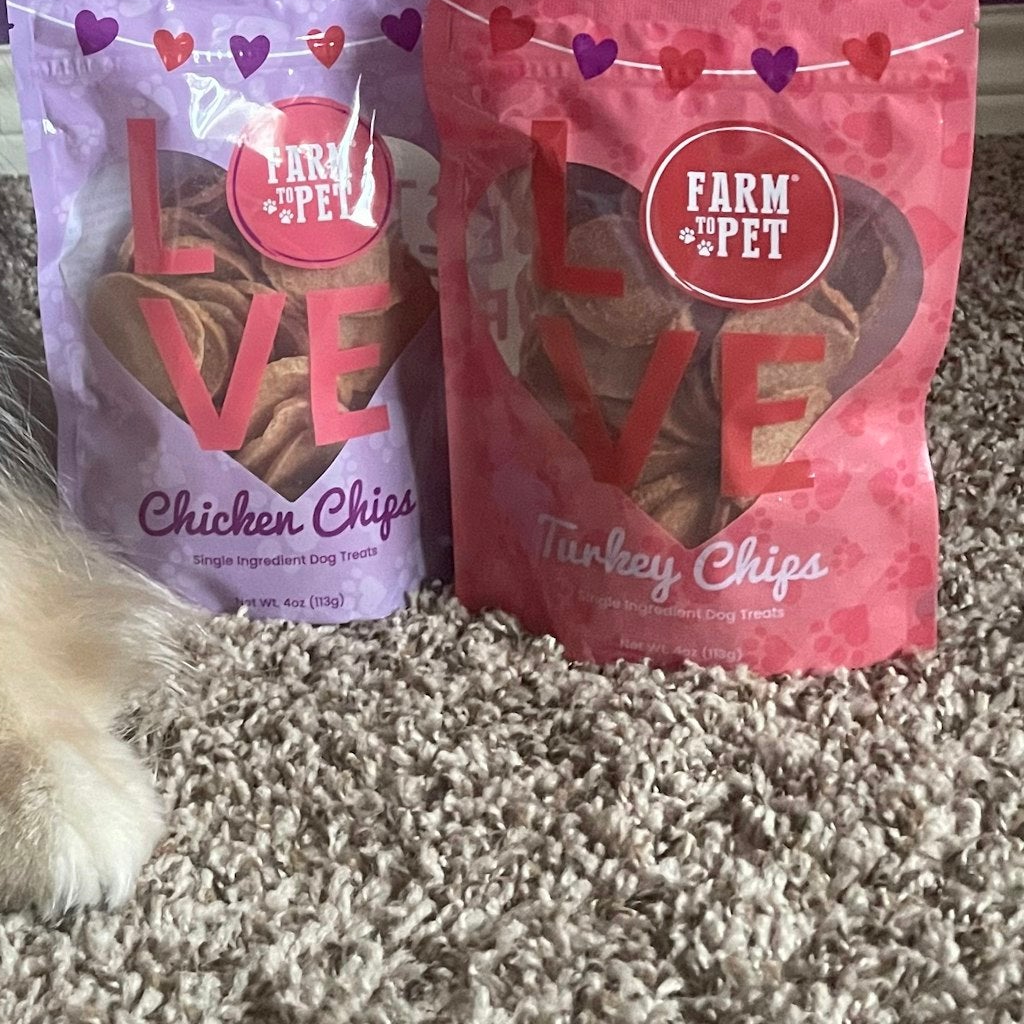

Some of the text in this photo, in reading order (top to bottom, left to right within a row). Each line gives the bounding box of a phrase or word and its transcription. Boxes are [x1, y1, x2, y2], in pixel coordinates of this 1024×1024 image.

[277, 180, 353, 224] TO PET
[687, 171, 789, 214] FARM
[695, 216, 788, 259] TO PET
[138, 479, 417, 541] Chicken Chips
[192, 546, 378, 569] Single Ingredient Dog Treats
[537, 513, 828, 603] Turkey Chips
[283, 596, 306, 608] 4oz
[309, 592, 345, 611] (113g)
[623, 599, 702, 619] Ingredient
[705, 608, 736, 624] Dog
[739, 607, 785, 622] Treats
